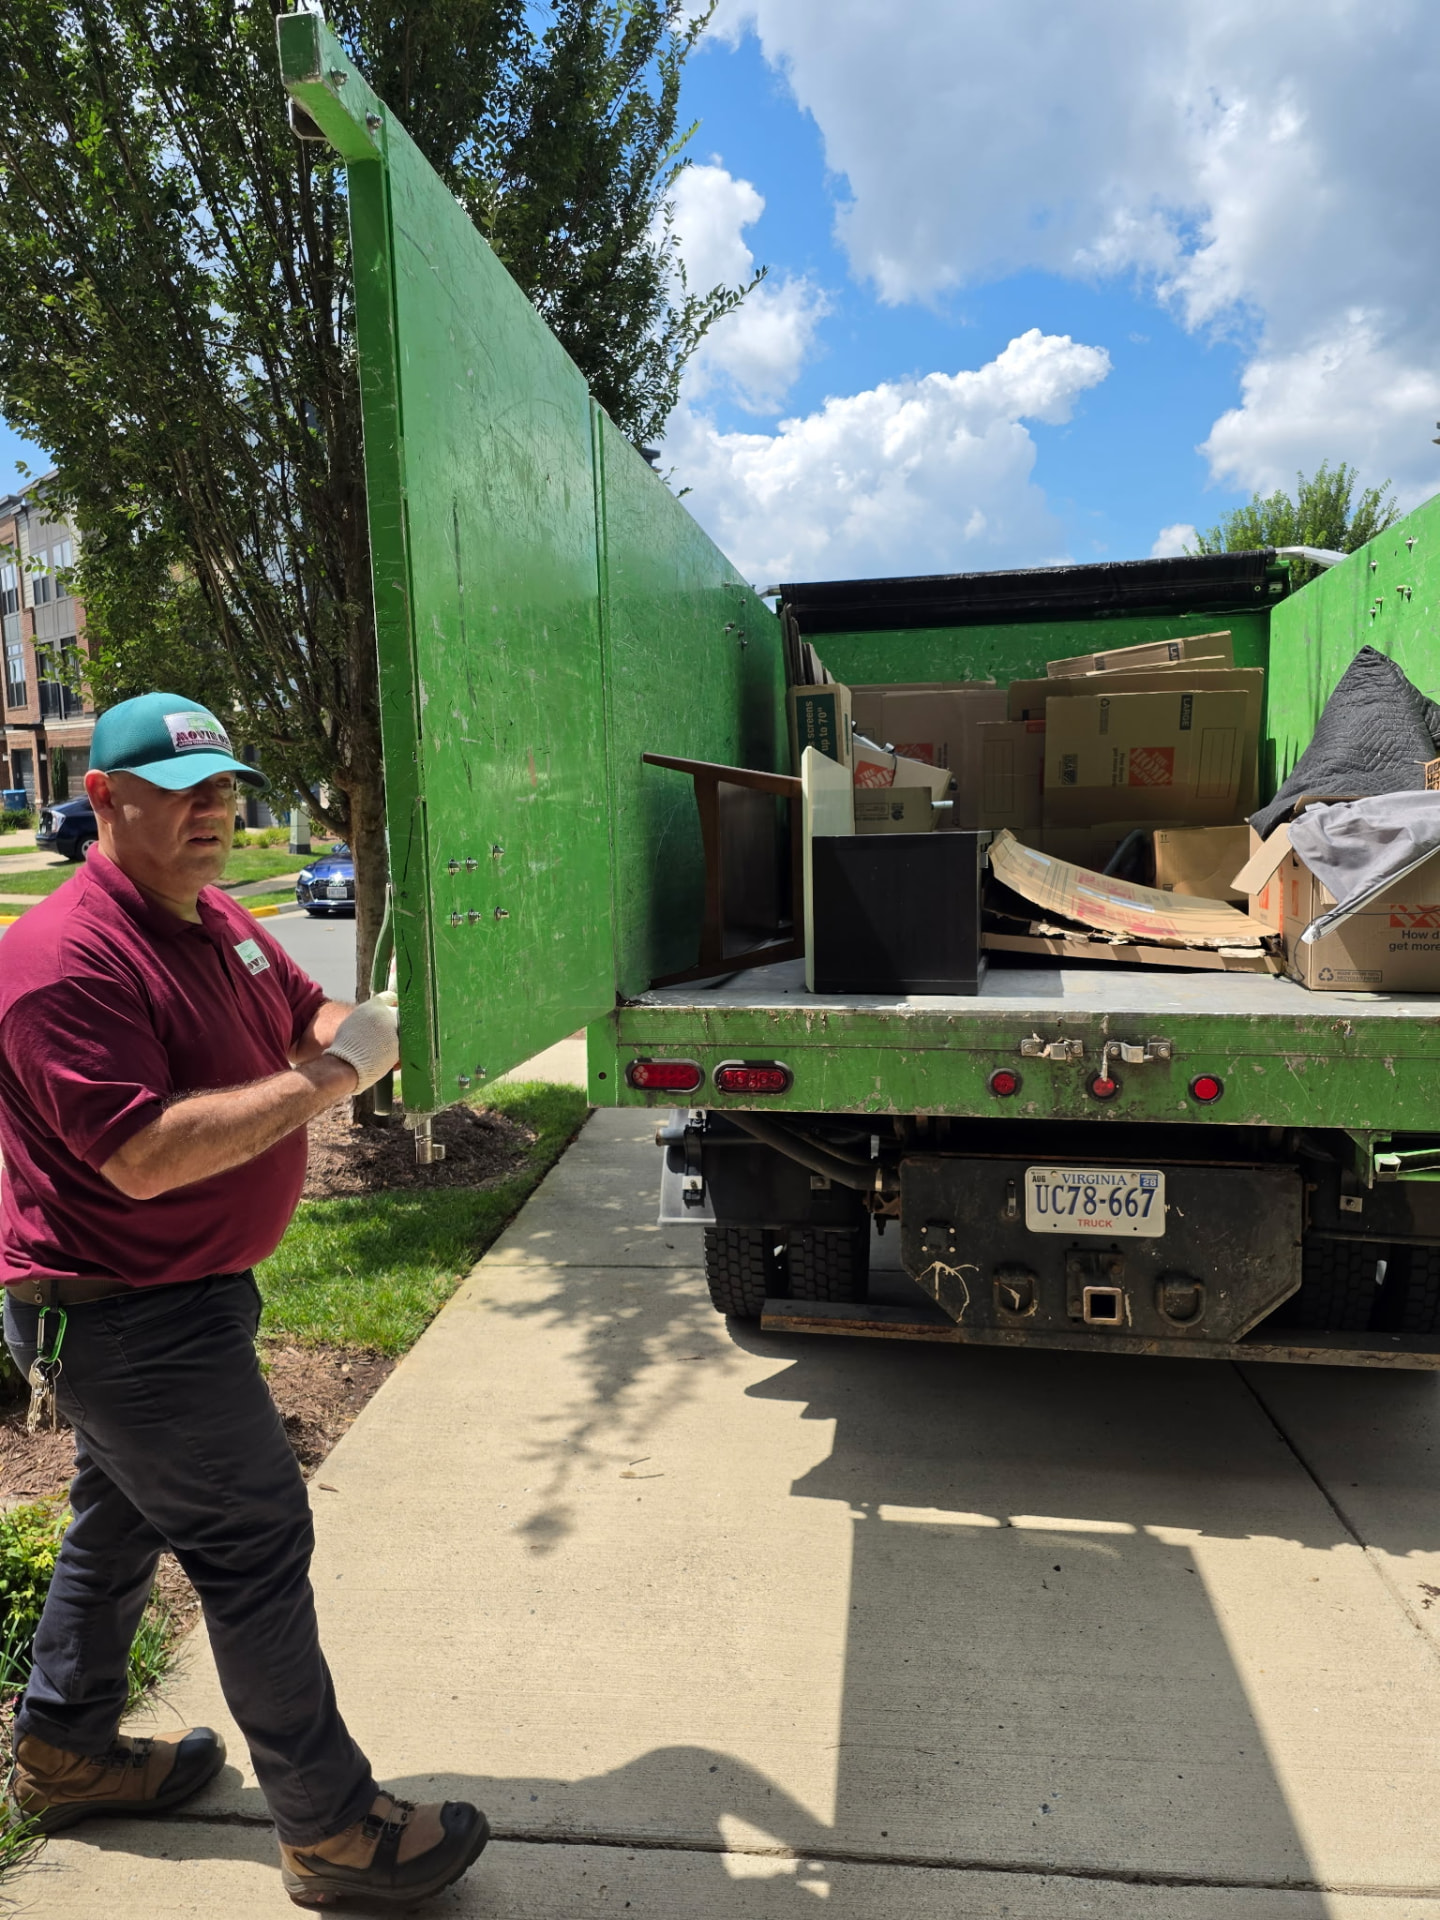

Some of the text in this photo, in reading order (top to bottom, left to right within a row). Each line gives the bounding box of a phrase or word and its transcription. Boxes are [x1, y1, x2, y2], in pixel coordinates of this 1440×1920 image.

[805, 700, 815, 739] screens
[1181, 697, 1191, 728] LARGE
[817, 707, 829, 751] up to 70"
[1130, 748, 1172, 785] HOME
[1402, 930, 1428, 939] How
[1388, 942, 1440, 952] get more
[1032, 1175, 1046, 1183] AUG
[1061, 1173, 1128, 1186] VIRGINIA
[1035, 1184, 1156, 1218] UC78-667
[1077, 1219, 1113, 1228] TRUCK
